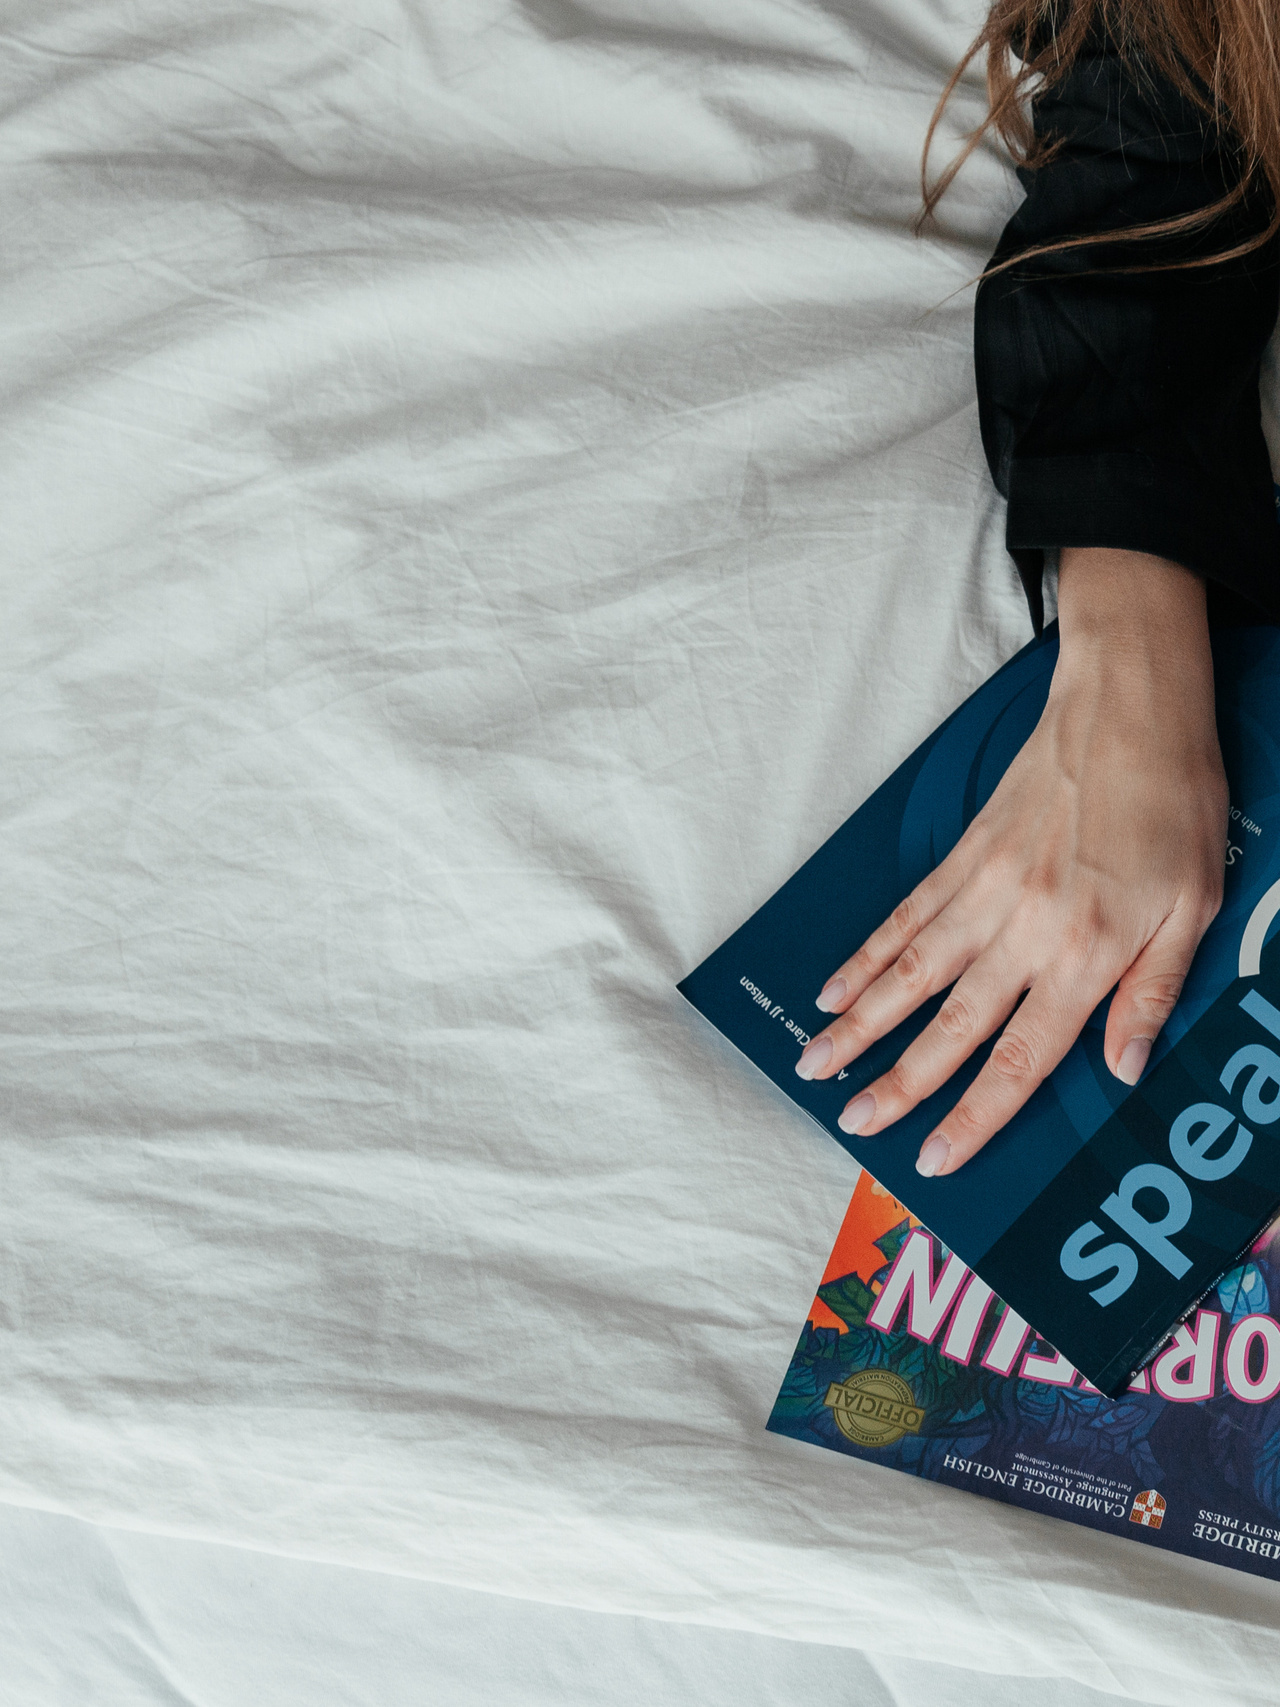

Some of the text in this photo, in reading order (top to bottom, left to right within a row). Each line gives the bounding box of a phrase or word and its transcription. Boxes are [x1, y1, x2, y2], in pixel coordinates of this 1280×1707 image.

[1241, 816, 1262, 837] with
[740, 976, 772, 1011] Wilson
[785, 1019, 811, 1047] Clare
[834, 1387, 920, 1427] OFFICIAL
[1014, 1452, 1051, 1469] Cambridge
[1011, 1462, 1129, 1505] Language Assessment
[1061, 1465, 1095, 1482] University
[1097, 1477, 1108, 1485] the
[943, 1454, 1126, 1518] CAMBRIDGE ENGLISH
[1121, 1482, 1132, 1492] Part
[1198, 1509, 1240, 1530] PRESS
